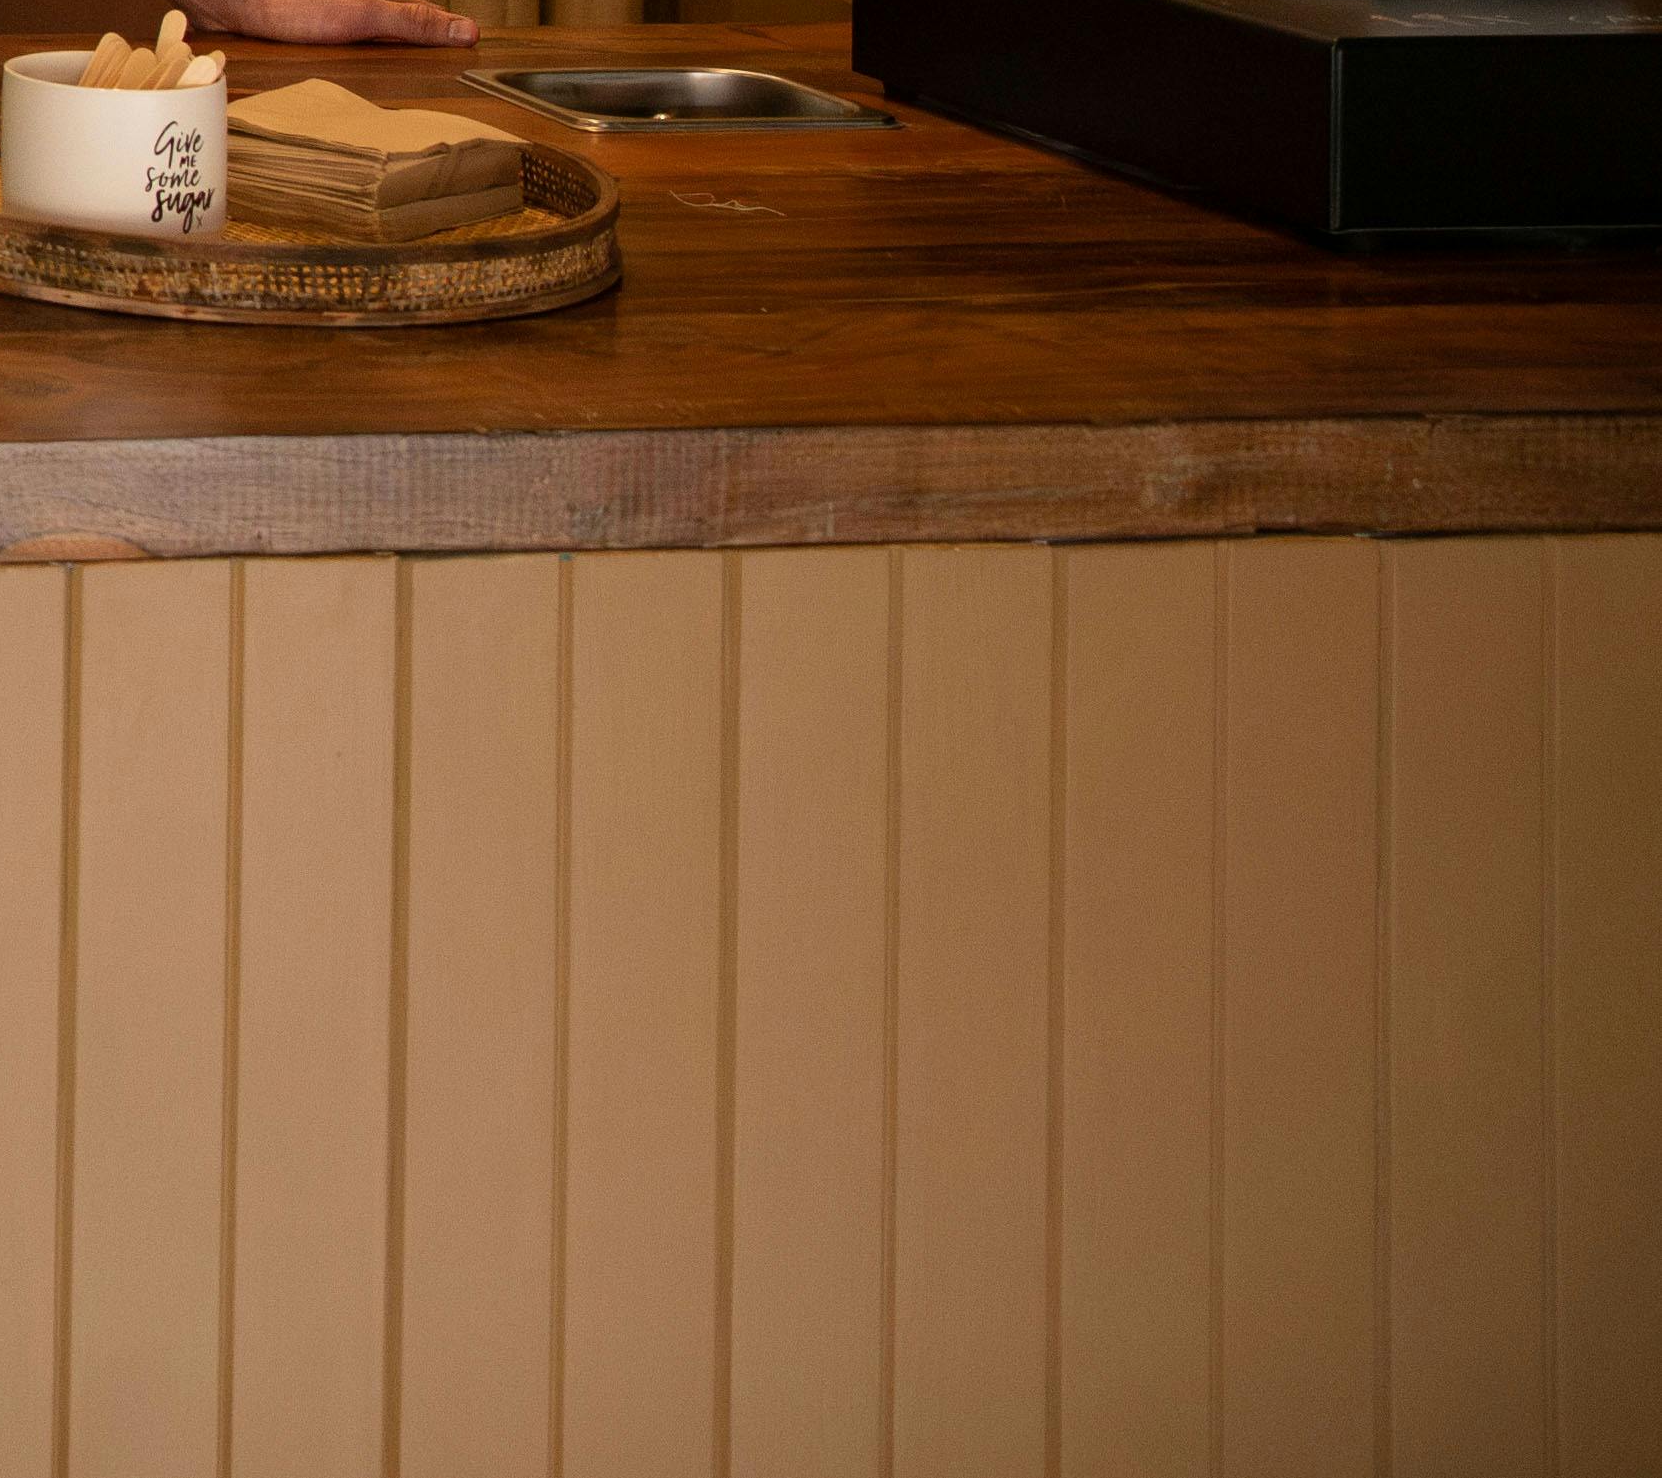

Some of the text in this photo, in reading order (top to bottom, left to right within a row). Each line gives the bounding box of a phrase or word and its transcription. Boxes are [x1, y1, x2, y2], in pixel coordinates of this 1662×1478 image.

[154, 121, 204, 169] Give
[179, 155, 196, 168] ME
[151, 188, 215, 234] sugar
